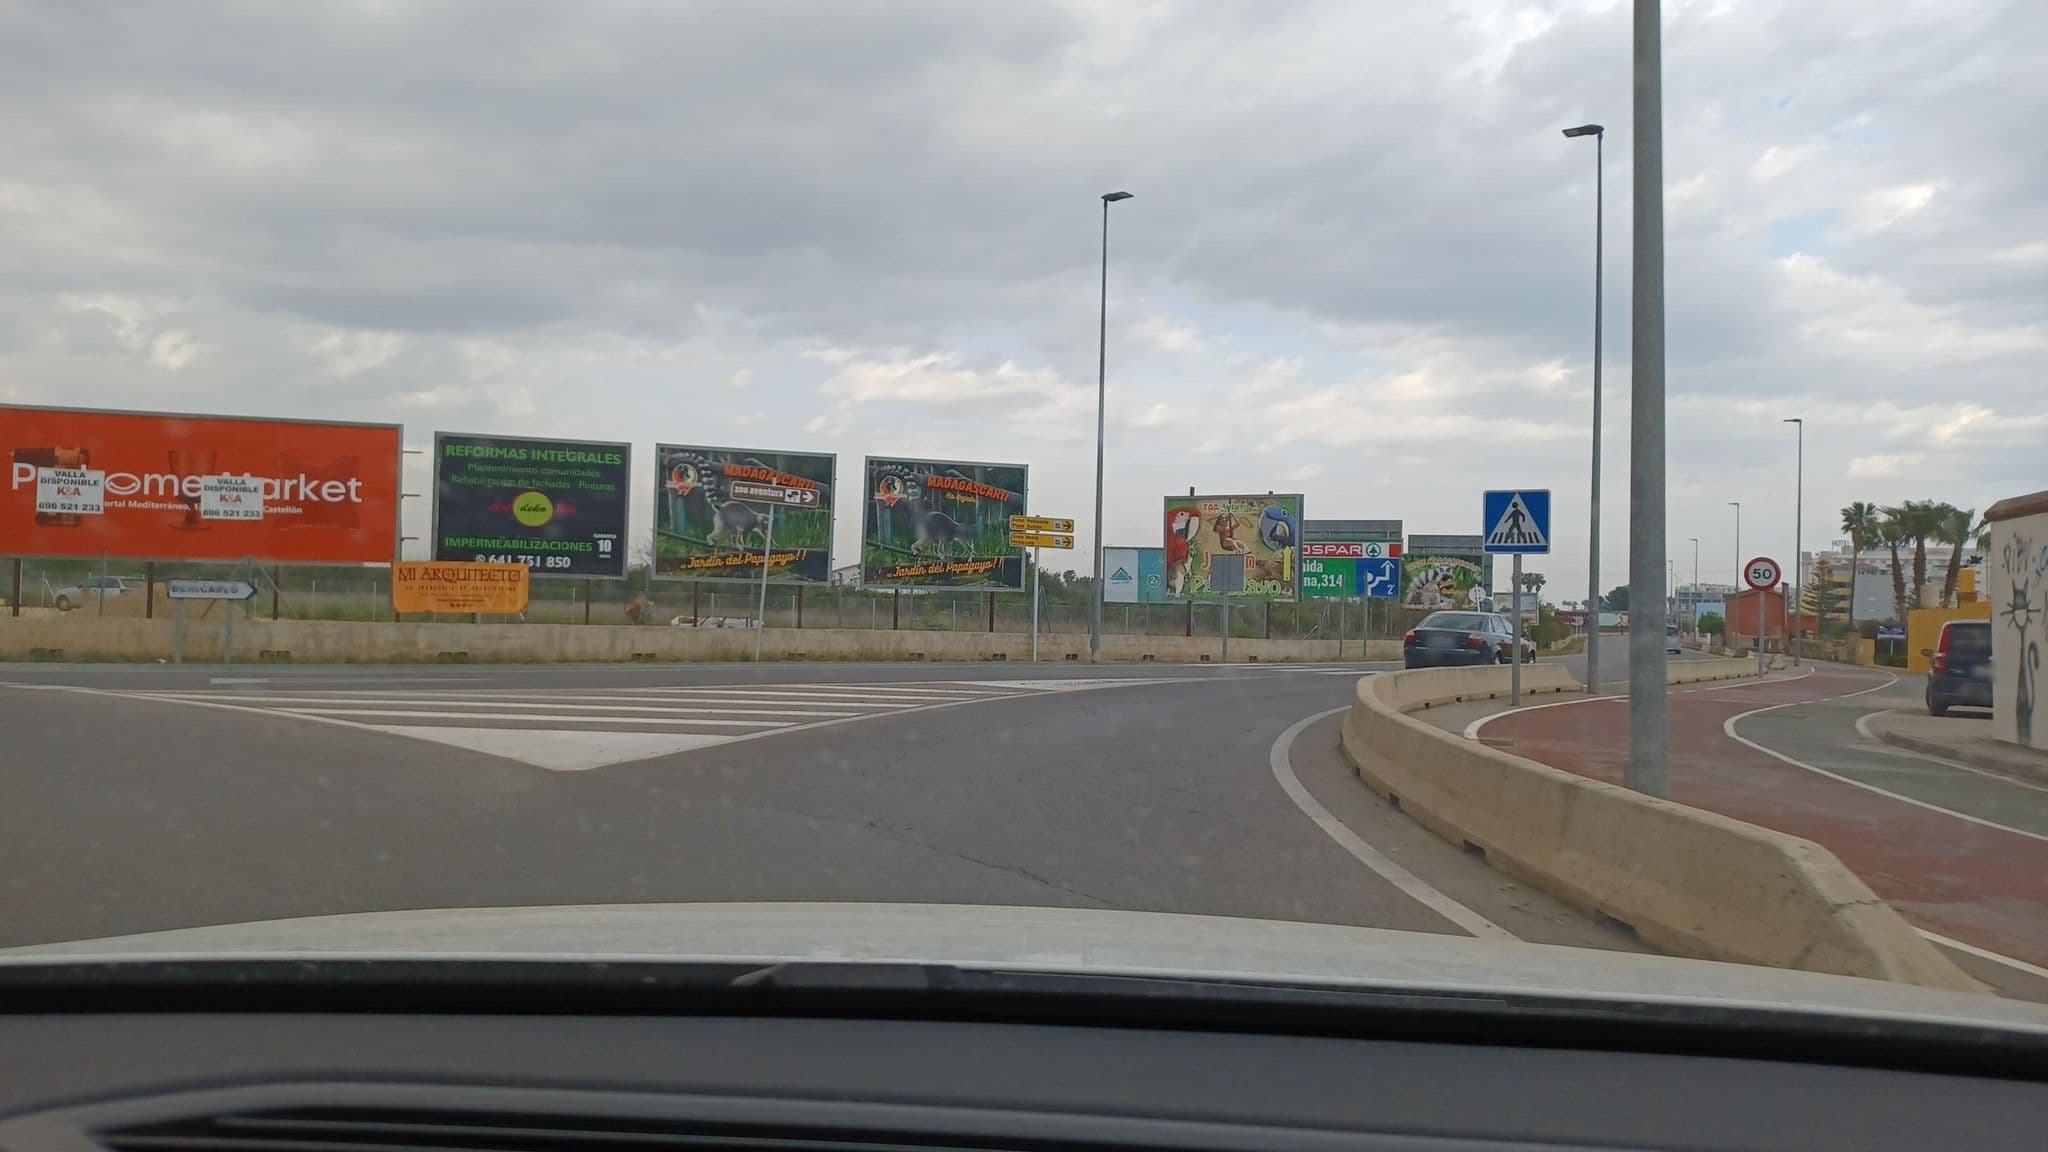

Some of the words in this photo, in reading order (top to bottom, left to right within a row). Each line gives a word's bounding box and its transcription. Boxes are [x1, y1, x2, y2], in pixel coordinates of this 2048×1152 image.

[446, 444, 527, 460] REFORMAS
[531, 448, 622, 465] INTEGRALES
[54, 470, 86, 479] VALLA
[467, 462, 538, 476] Mantenimiento
[540, 466, 600, 478] comunidades
[40, 477, 100, 487] DISPONIBLE
[217, 478, 247, 486] VALLA
[222, 472, 362, 503] arket
[518, 478, 529, 487] de
[531, 479, 571, 489] fachadas
[578, 480, 616, 491] Pinturas
[204, 484, 259, 494] DISPONIBLE
[734, 485, 749, 494] zoo
[749, 487, 784, 498] aventura
[38, 502, 58, 510] 696
[60, 502, 79, 511] 521
[82, 503, 101, 512] 233
[104, 501, 126, 509] ortal
[128, 501, 192, 512] Mediterráneo,
[263, 504, 303, 515] Castellón
[519, 502, 547, 513] deko
[203, 509, 220, 517] 696
[223, 509, 240, 517] 521
[243, 510, 260, 518] 233
[445, 537, 593, 552] IMPERMEABILIZACIONES
[597, 538, 612, 553] 10
[488, 553, 512, 564] 641
[518, 554, 541, 568] 751
[546, 556, 571, 568] 850
[726, 553, 744, 566] del
[745, 549, 807, 567] Papgayo!!
[928, 562, 945, 574] del
[946, 557, 1003, 575] Papagayo!!
[398, 567, 416, 581] MI
[420, 567, 520, 583] ARQUITECTO
[1753, 568, 1772, 579] 50
[1190, 575, 1282, 597] Paayo
